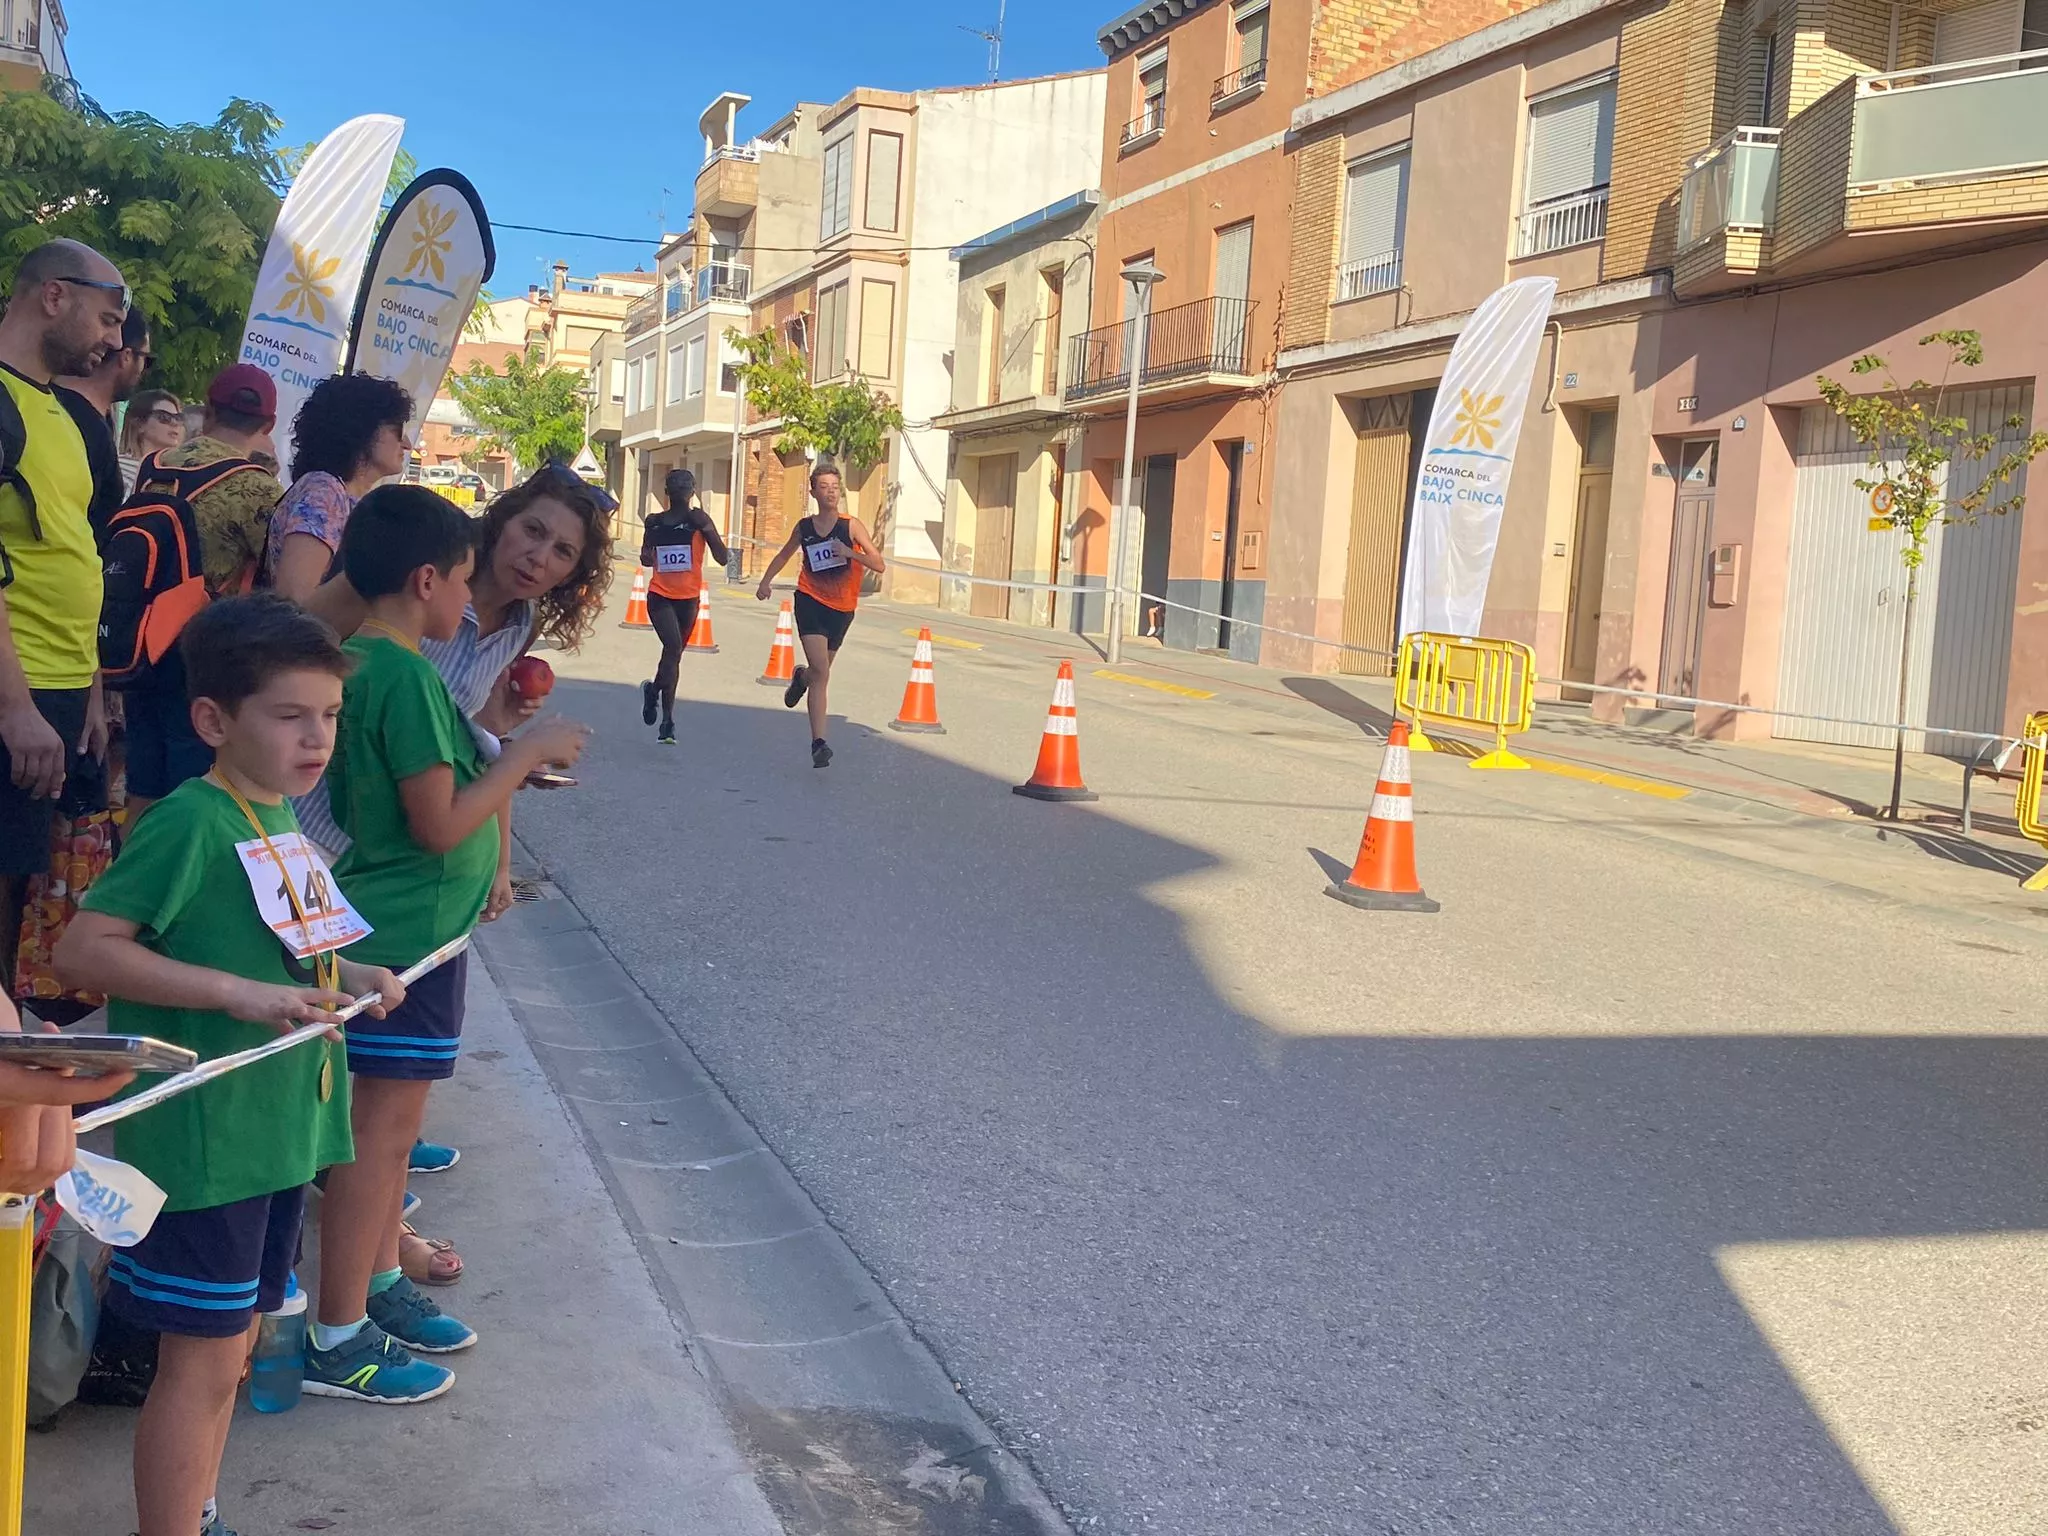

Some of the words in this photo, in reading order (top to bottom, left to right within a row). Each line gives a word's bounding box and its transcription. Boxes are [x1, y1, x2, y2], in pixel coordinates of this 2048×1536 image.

[381, 298, 425, 321] COMARCA
[427, 314, 439, 327] DEL
[377, 313, 407, 335] BAJO
[243, 345, 280, 367] BAJO
[248, 332, 301, 357] COMARCA
[303, 352, 319, 364] DEL
[374, 333, 404, 356] BAIX
[408, 335, 451, 359] CINCA
[281, 368, 318, 390] CINC
[1566, 374, 1577, 386] 22
[1422, 475, 1455, 490] BAJO
[1424, 464, 1475, 480] COMARCA
[1477, 473, 1491, 482] DEL
[1420, 490, 1452, 504] BAIX
[1457, 488, 1504, 507] CINCA
[663, 553, 686, 564] 102
[276, 870, 332, 921] 148
